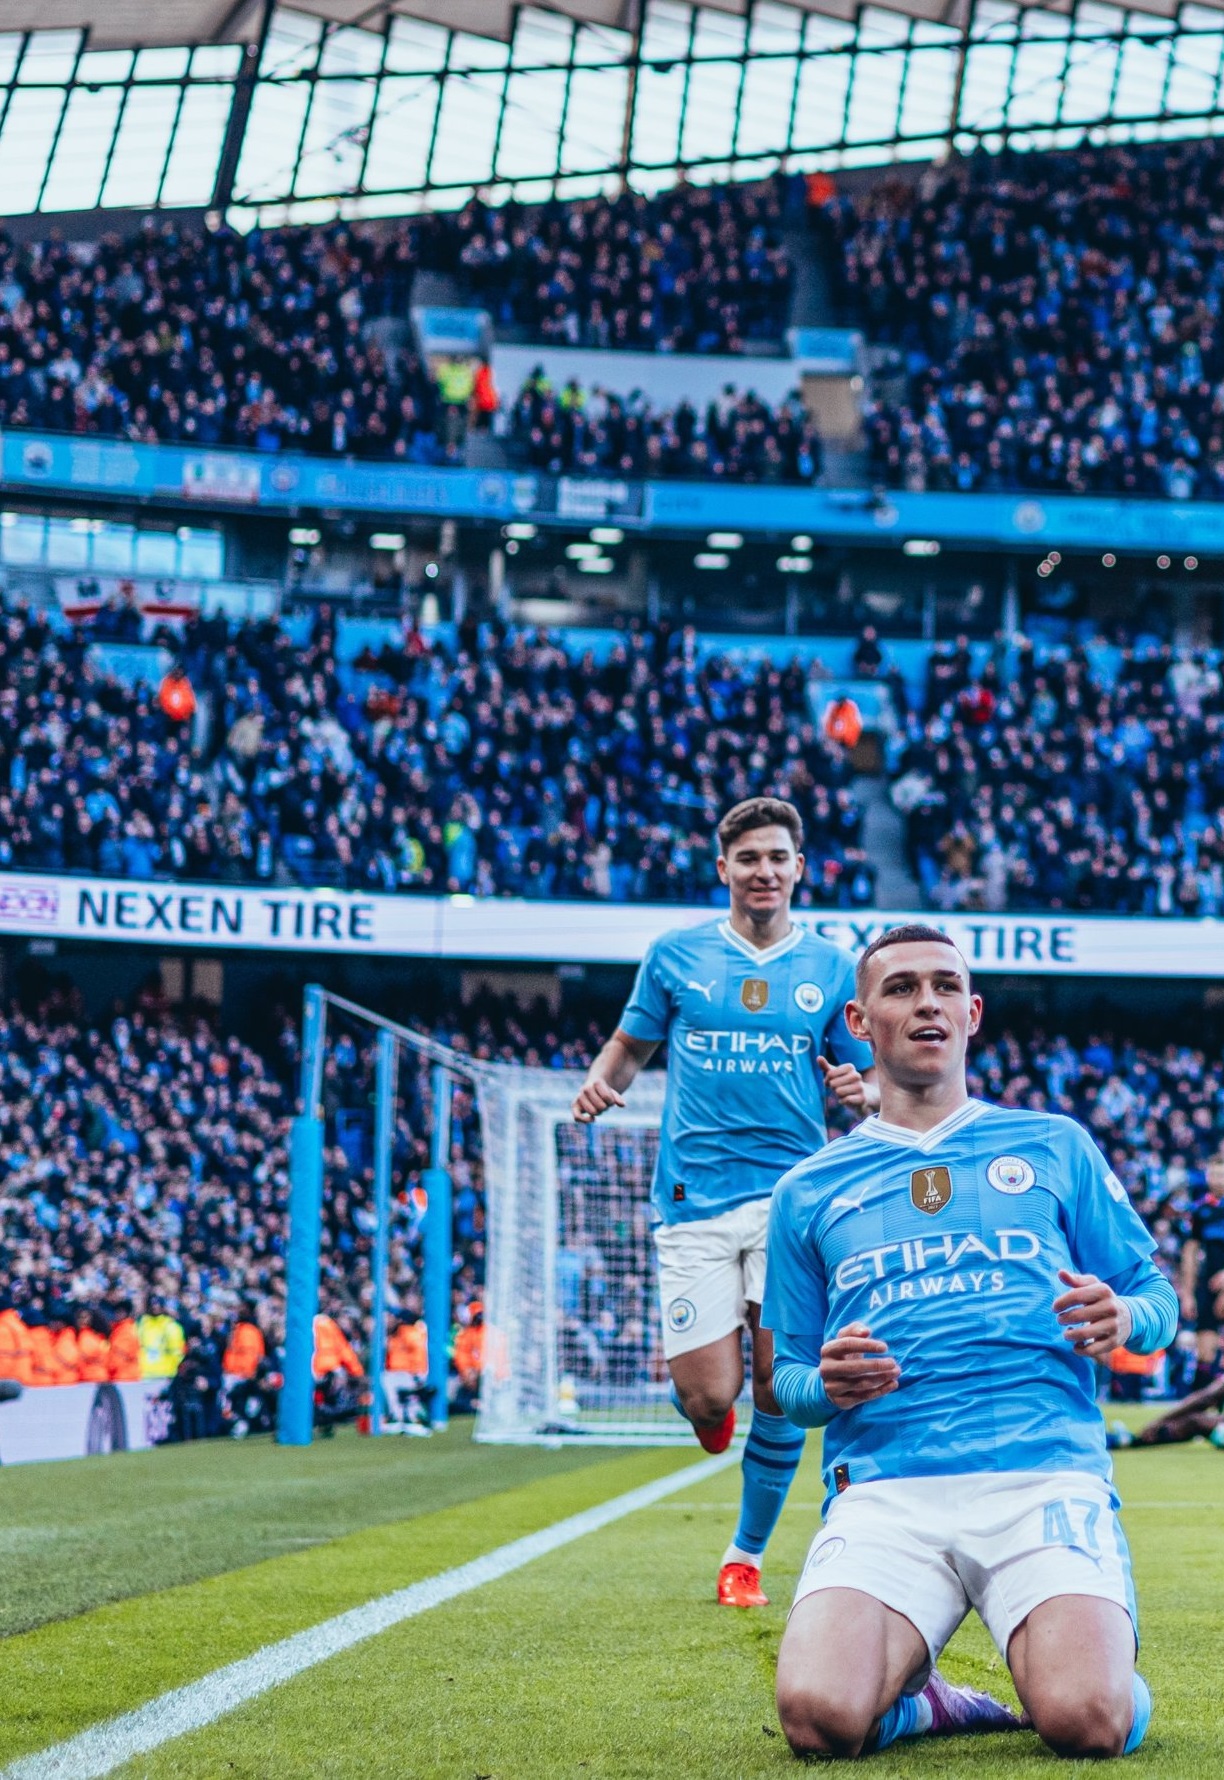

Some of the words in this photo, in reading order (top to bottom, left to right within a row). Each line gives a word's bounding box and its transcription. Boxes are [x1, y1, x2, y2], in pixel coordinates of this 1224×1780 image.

[77, 889, 243, 934] NEXEN
[263, 899, 375, 941] TIRE
[965, 924, 1078, 963] TIRE
[686, 1031, 811, 1054] ETIHAD
[703, 1058, 794, 1074] AIRWAYS
[923, 1195, 942, 1204] FIFA
[835, 1229, 1041, 1291] ETIHAD
[869, 1271, 1005, 1309] AIRWAYS
[1042, 1497, 1101, 1550] 47
